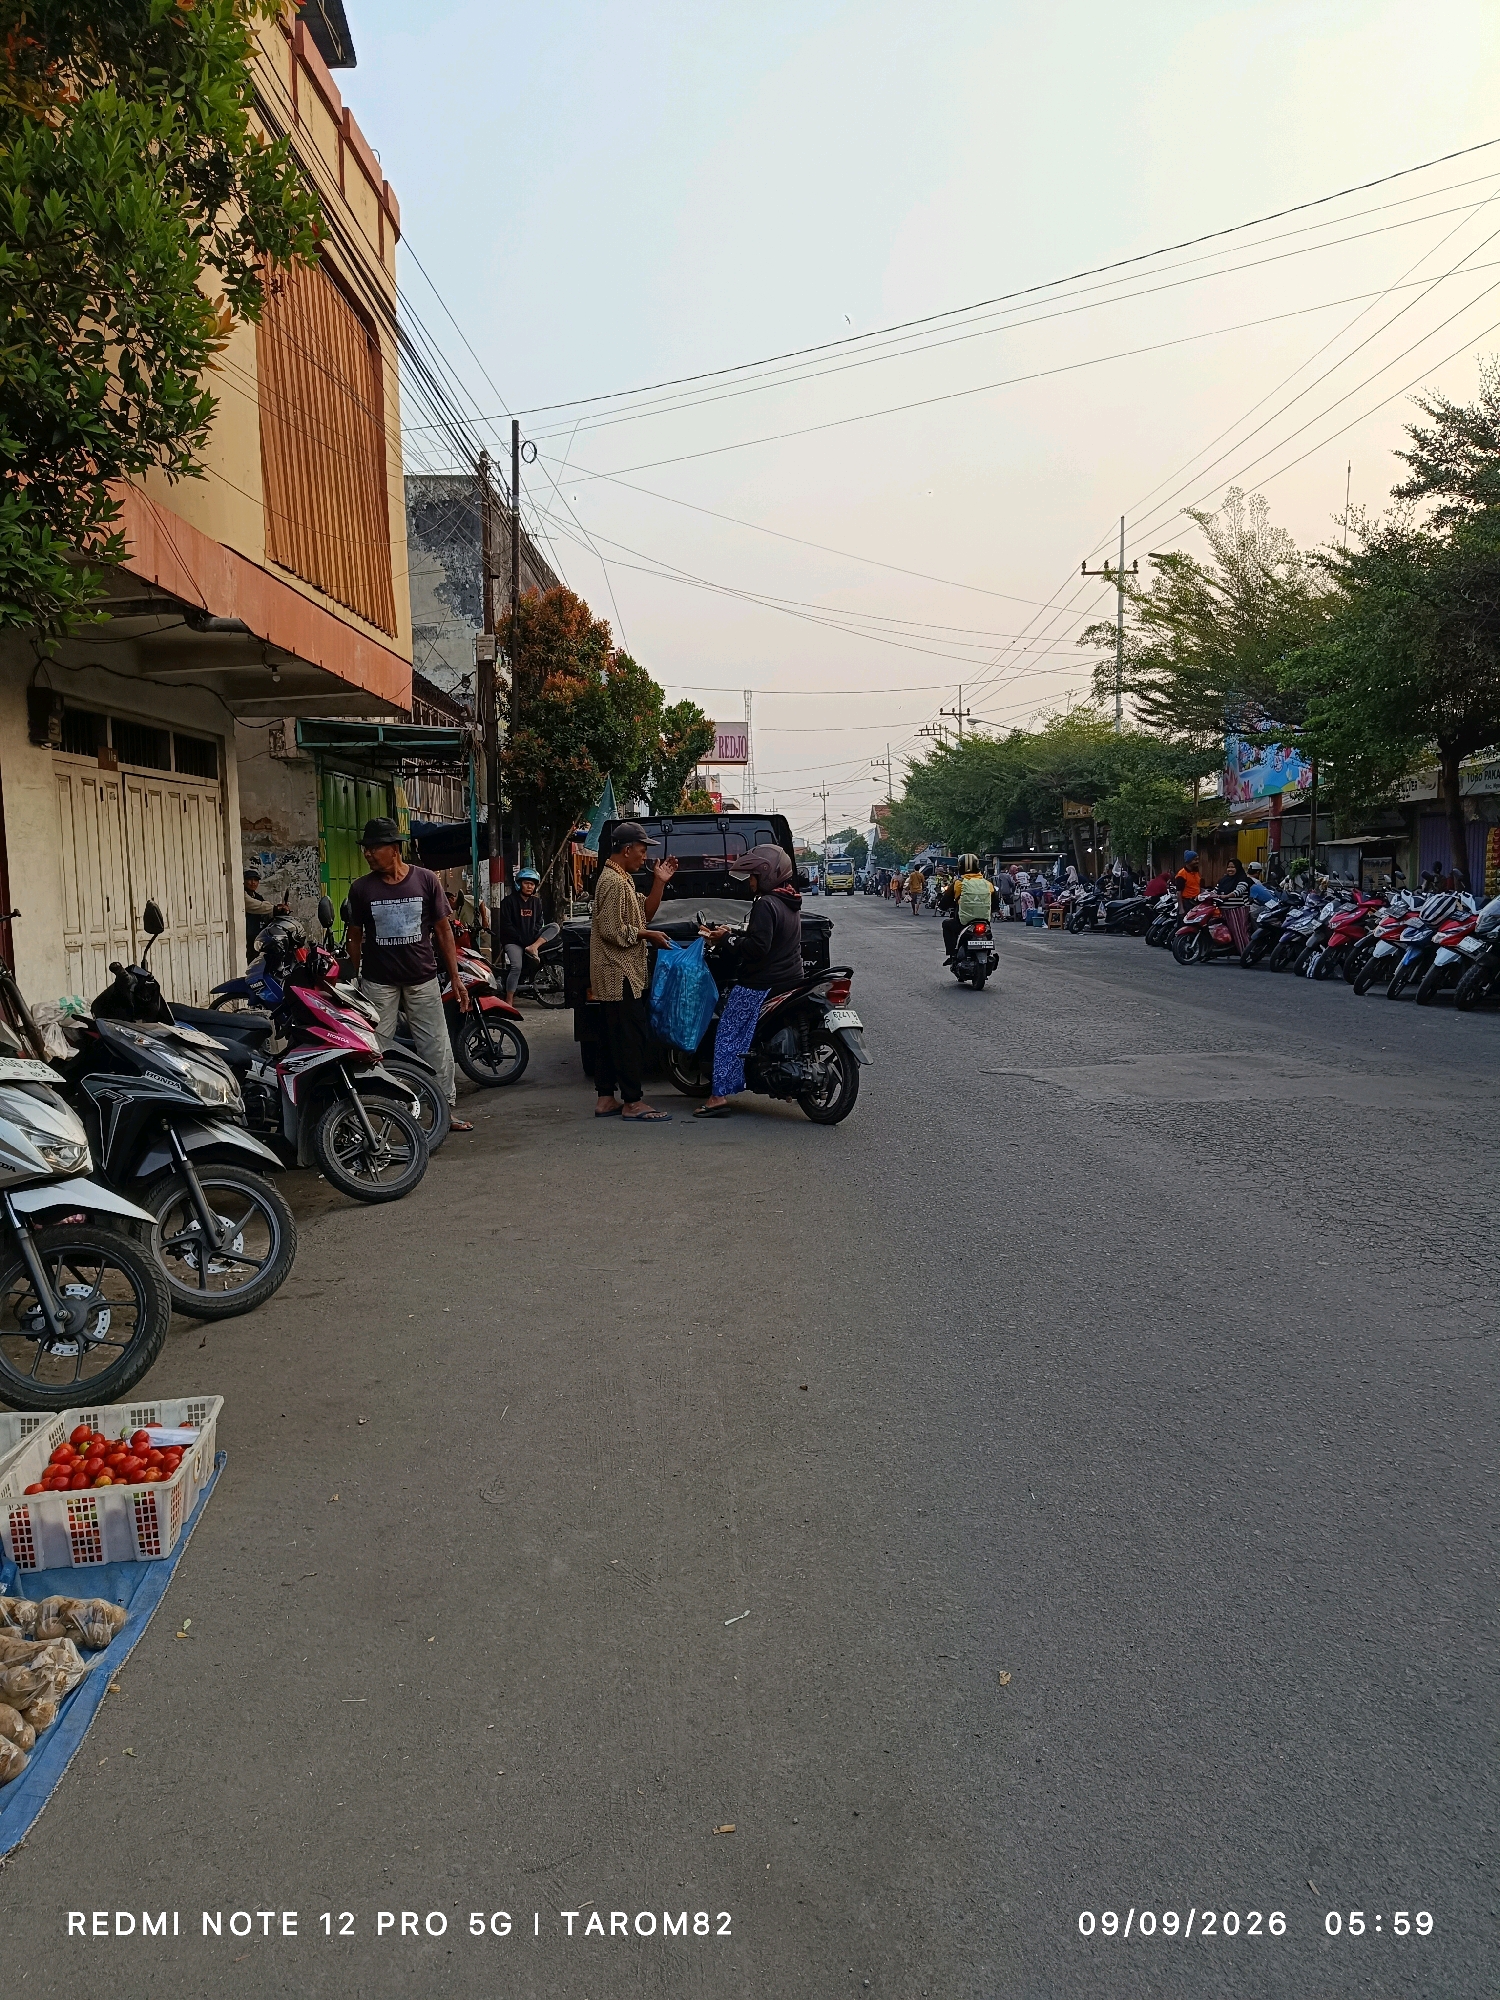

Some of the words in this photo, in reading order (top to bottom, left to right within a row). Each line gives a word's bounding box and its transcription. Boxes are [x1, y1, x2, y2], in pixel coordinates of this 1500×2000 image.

[718, 735, 747, 759] REDJO
[327, 1032, 350, 1044] HONDA
[145, 1070, 181, 1089] HONDA
[0, 1161, 17, 1173] DA
